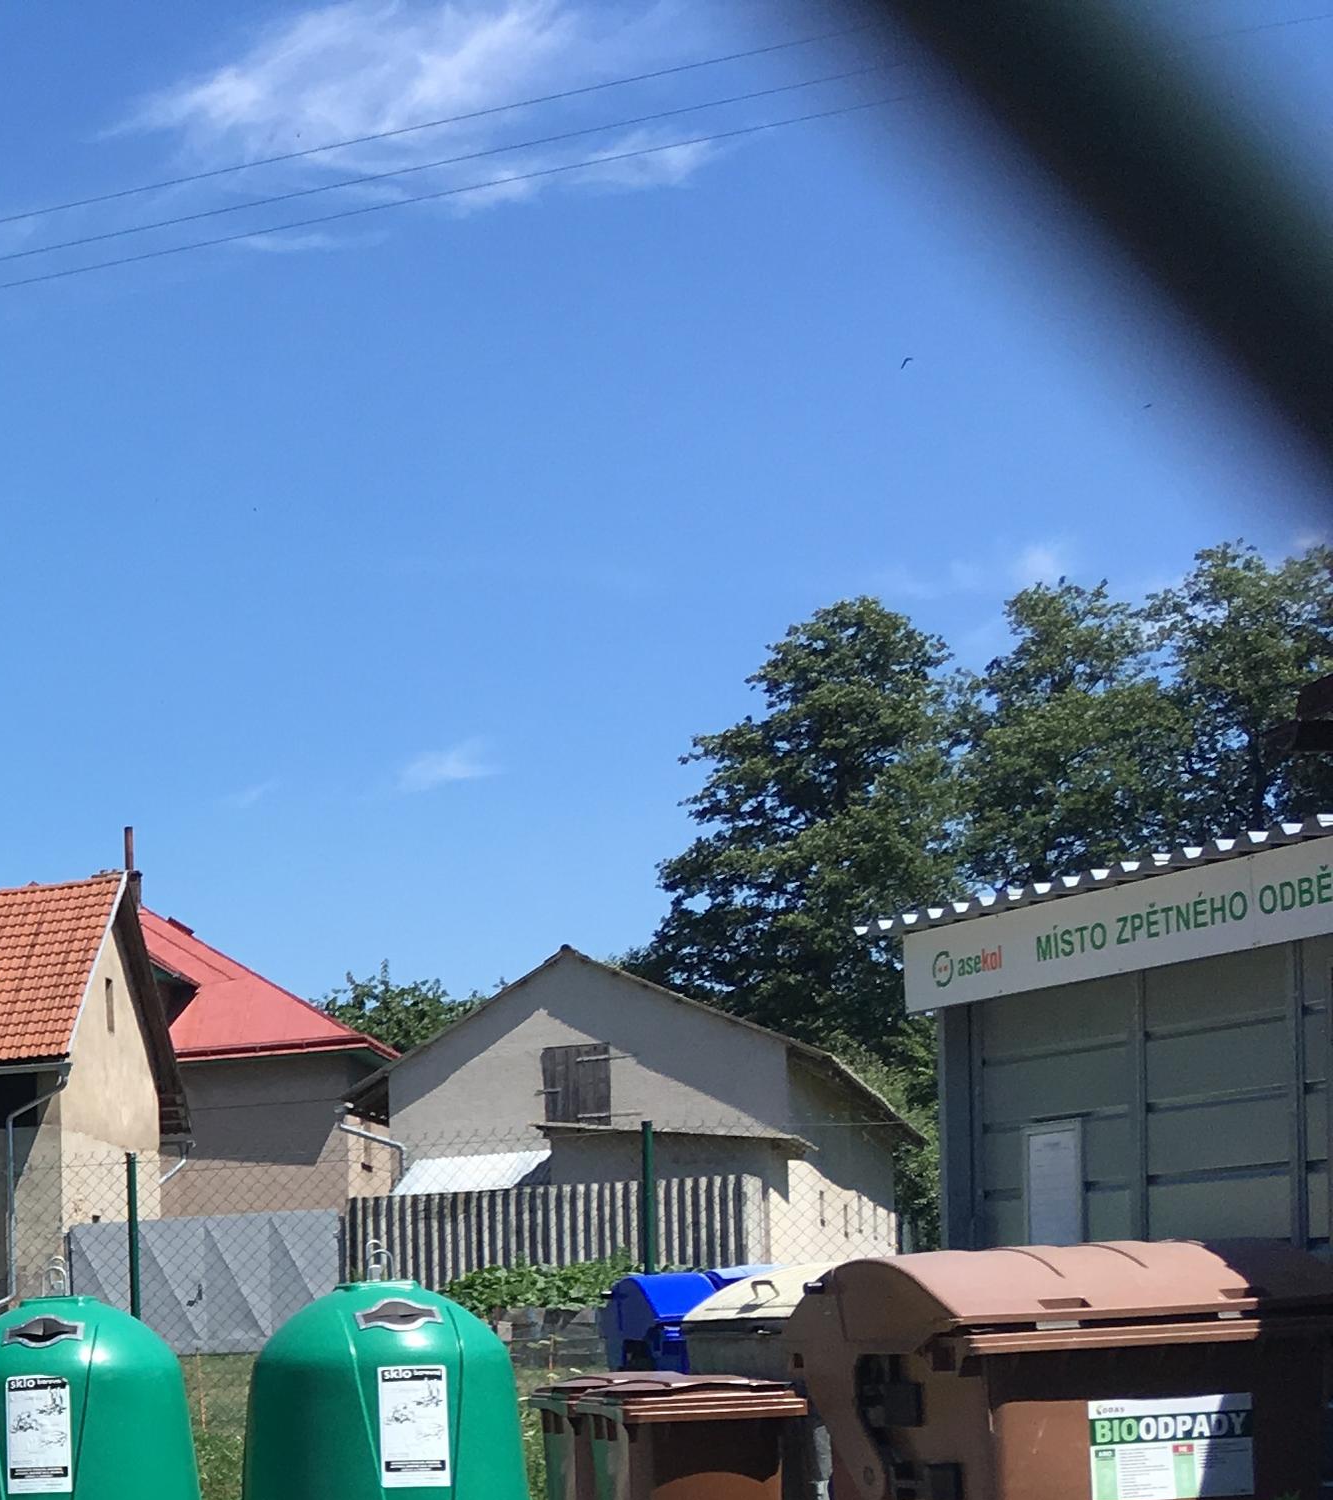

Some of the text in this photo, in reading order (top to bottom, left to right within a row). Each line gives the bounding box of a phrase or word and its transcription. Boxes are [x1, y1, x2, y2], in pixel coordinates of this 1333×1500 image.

[1036, 864, 1333, 962] MÍSTO ZPĚTNÉHO ODBĚ
[958, 945, 1002, 976] asekol
[10, 1379, 36, 1389] sklo
[383, 1368, 413, 1379] sklo
[1095, 1412, 1246, 1443] BIOODPADY
